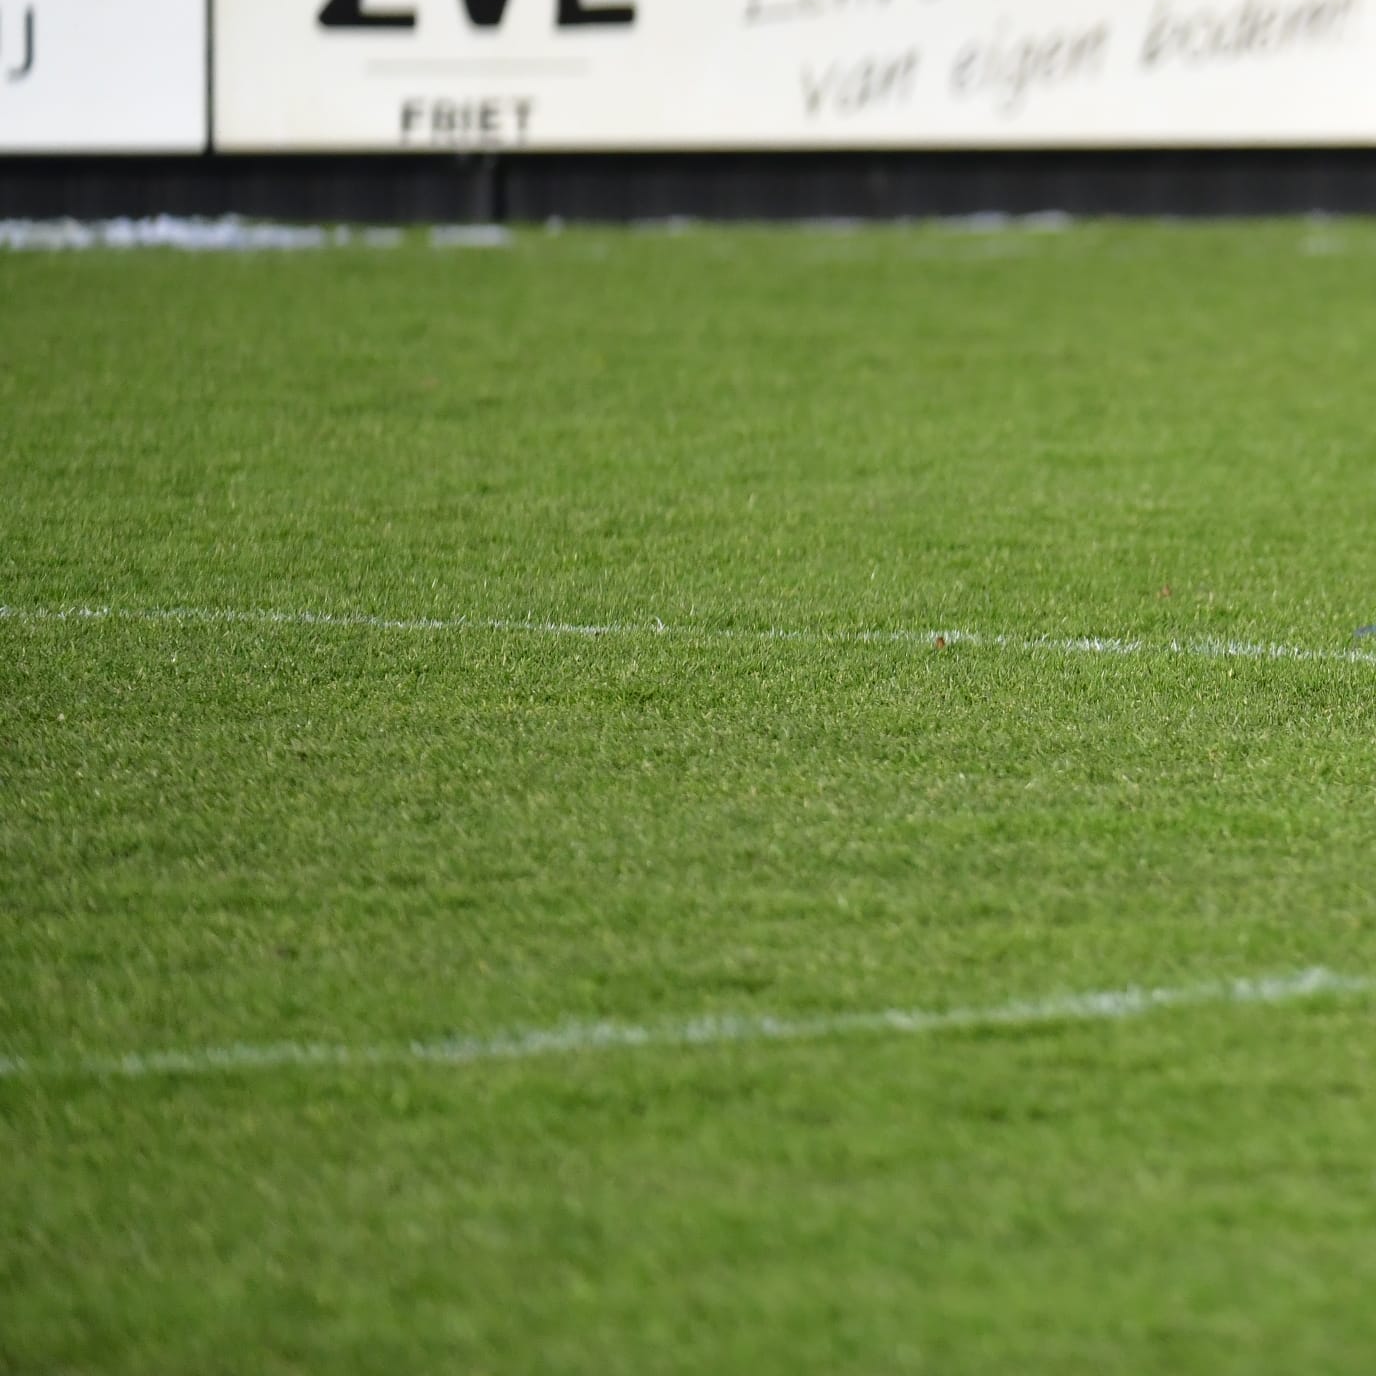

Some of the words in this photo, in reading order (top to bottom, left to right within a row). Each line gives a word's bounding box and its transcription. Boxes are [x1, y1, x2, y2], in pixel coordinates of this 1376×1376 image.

[797, 39, 924, 120] van
[948, 16, 1110, 116] eigen
[402, 98, 534, 147] FRIET
